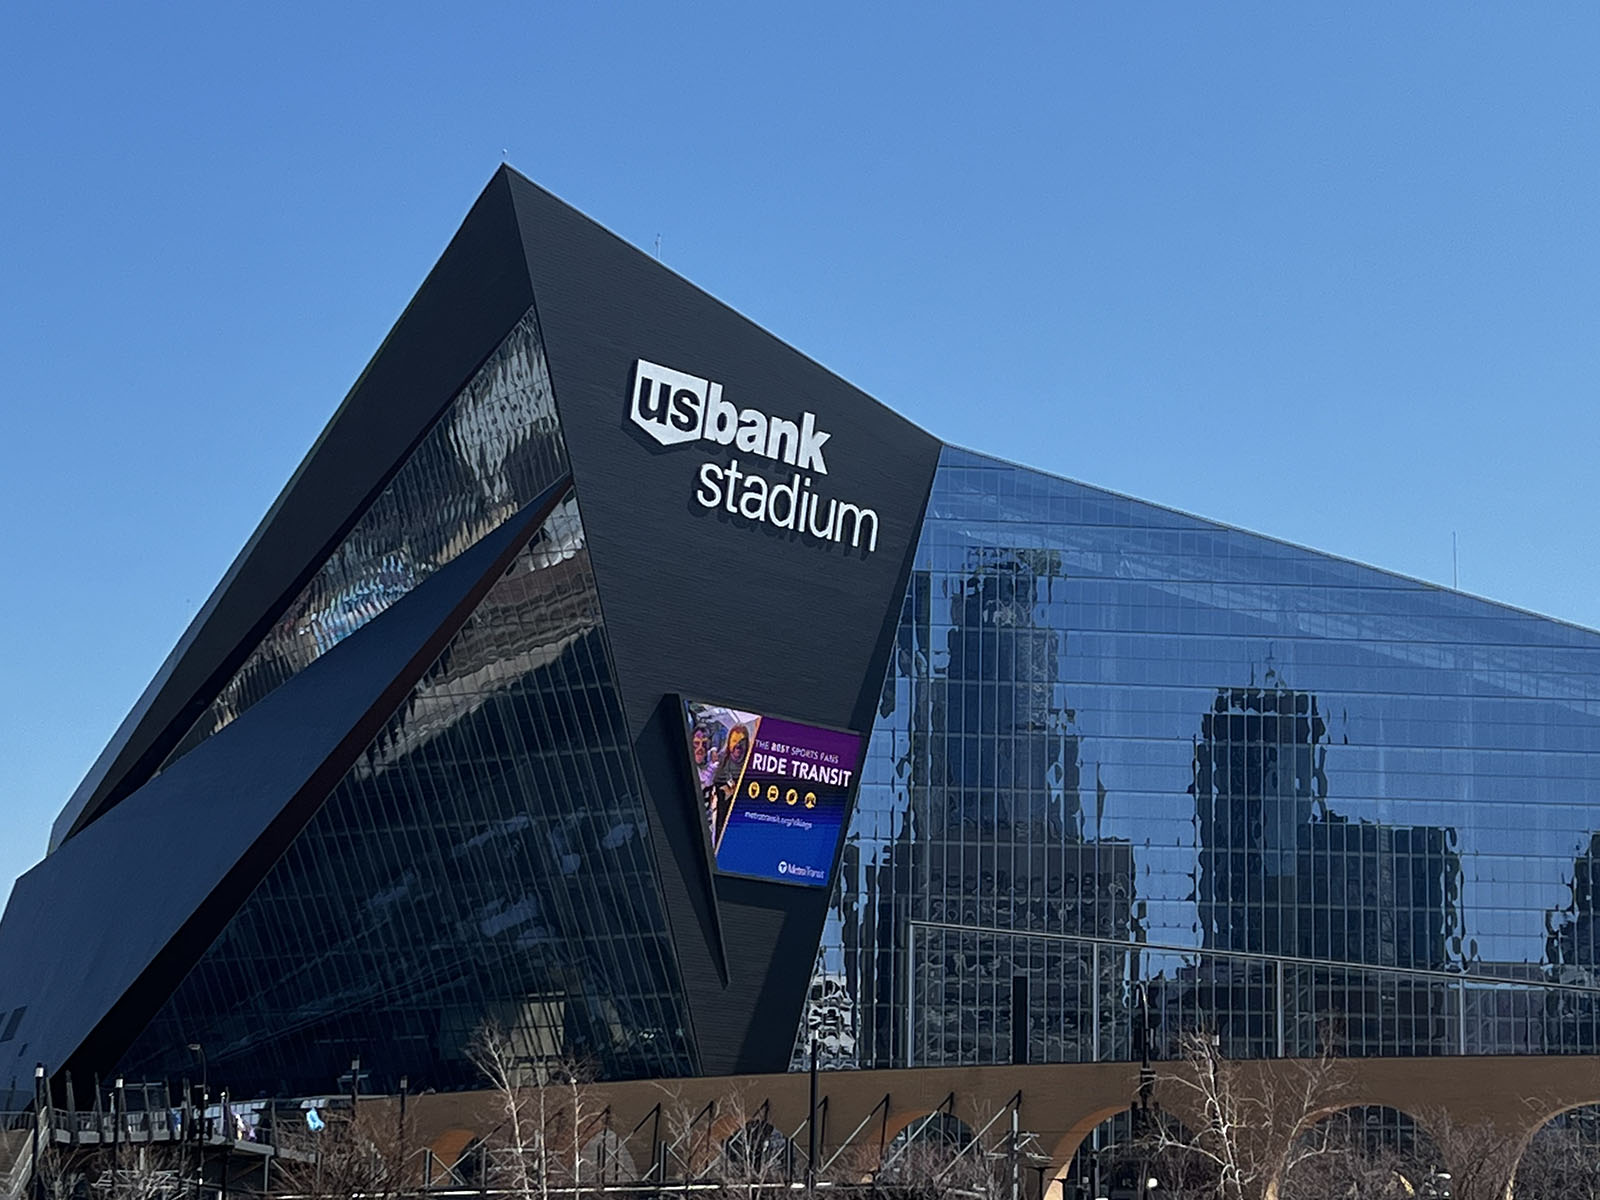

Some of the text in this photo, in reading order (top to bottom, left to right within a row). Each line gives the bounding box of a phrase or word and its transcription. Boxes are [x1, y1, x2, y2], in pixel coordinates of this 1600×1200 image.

[697, 459, 879, 552] stadium
[755, 739, 839, 764] THE BEST SPORTS FANS
[752, 753, 852, 788] RIDE TRANSIT
